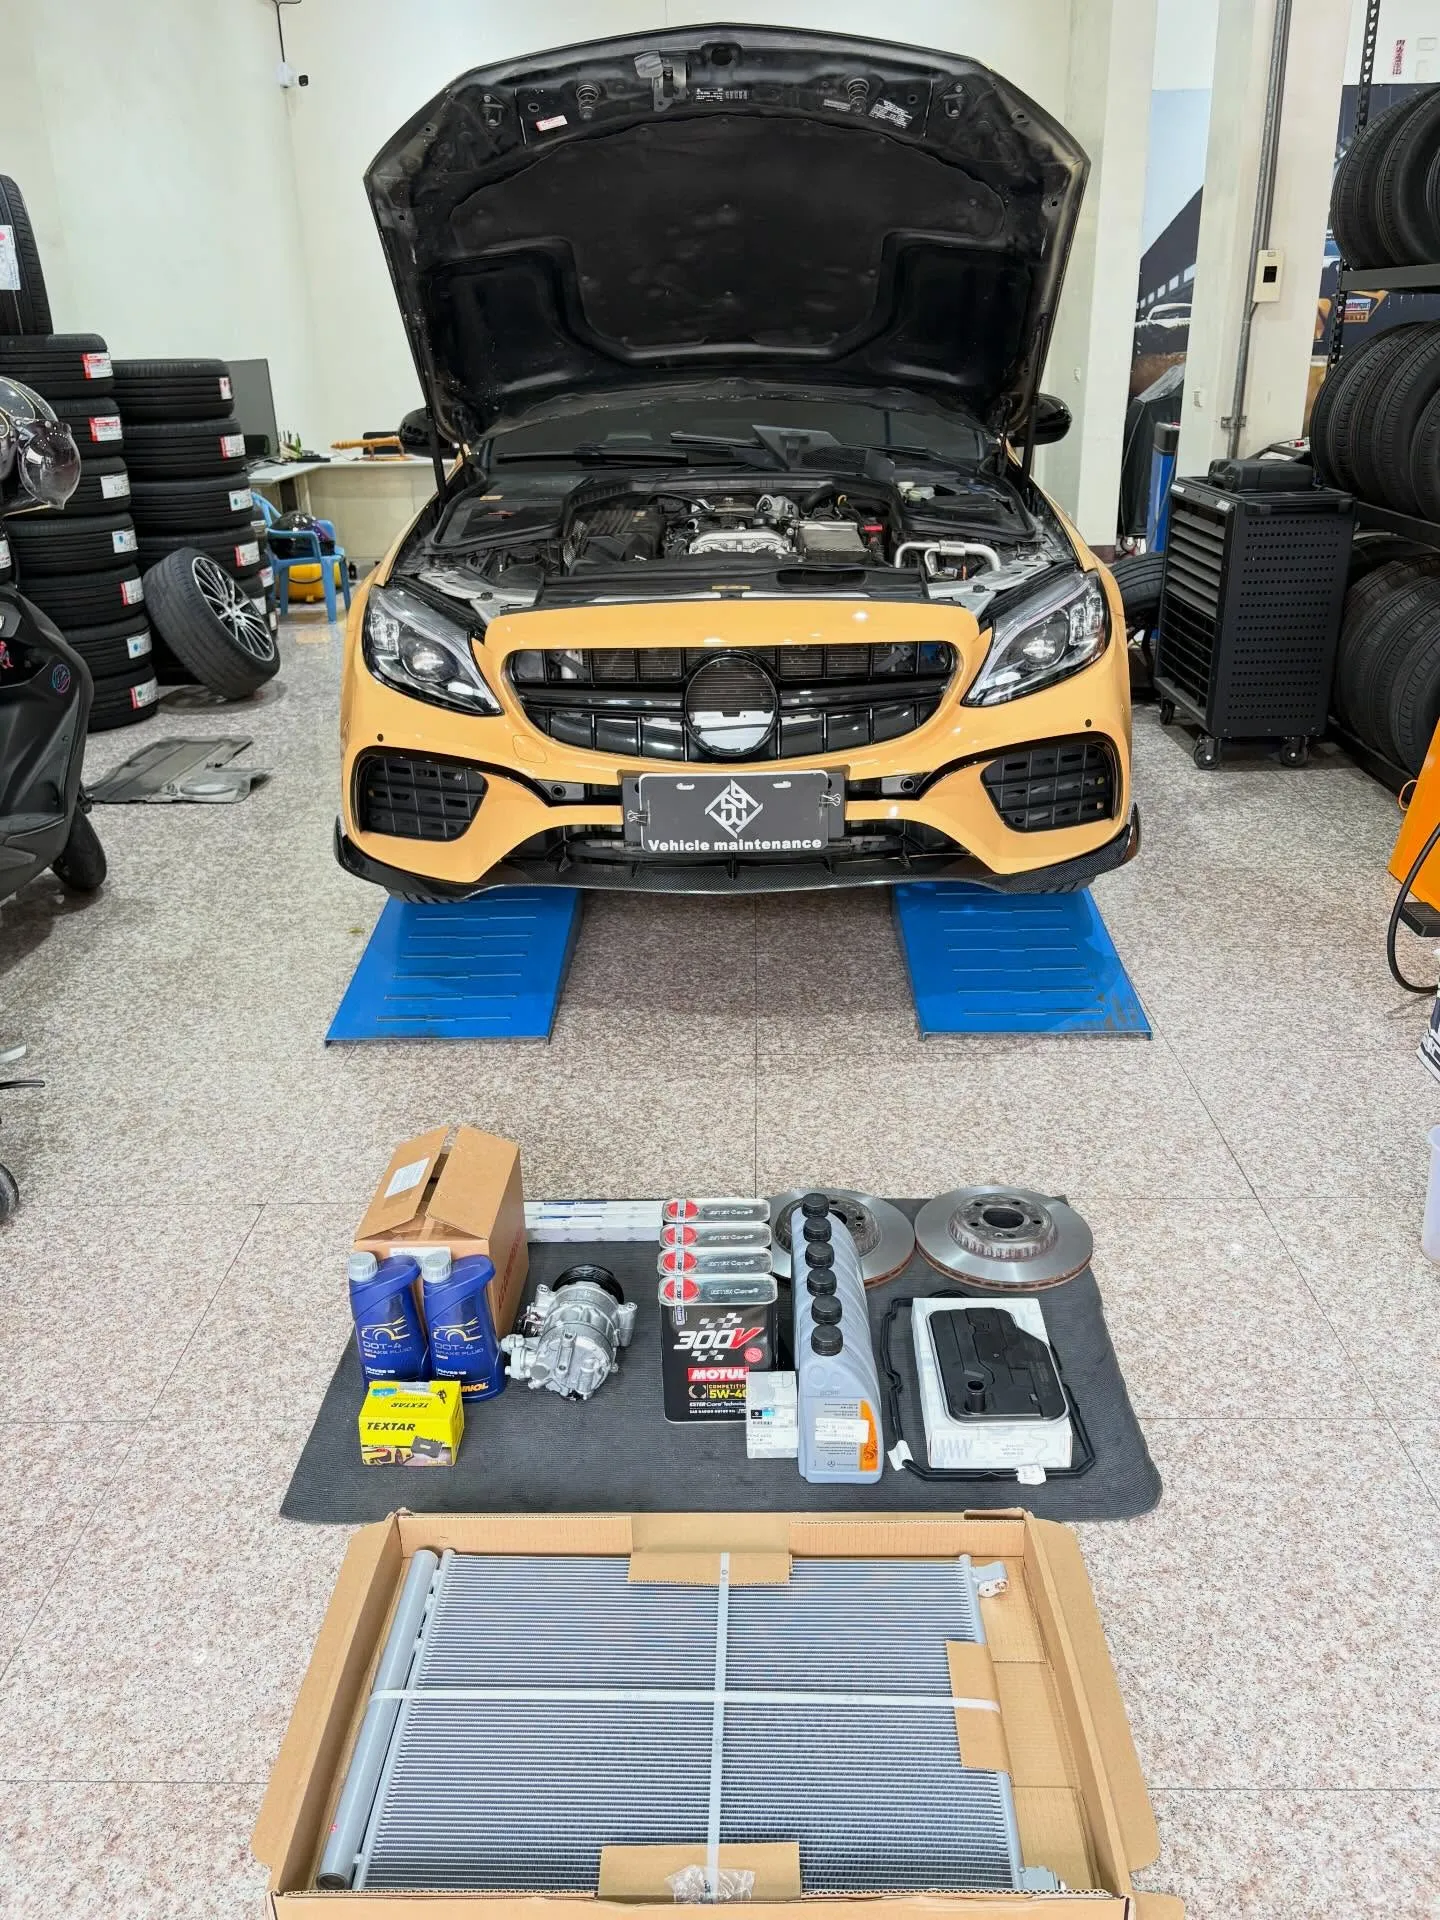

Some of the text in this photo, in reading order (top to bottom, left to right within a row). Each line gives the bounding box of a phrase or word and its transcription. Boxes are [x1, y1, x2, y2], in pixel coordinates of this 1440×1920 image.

[647, 838, 822, 851] Vehicle maintenance
[673, 1327, 764, 1349] 300V
[691, 1369, 747, 1380] MOTUL
[367, 1422, 416, 1432] TEXTAR
